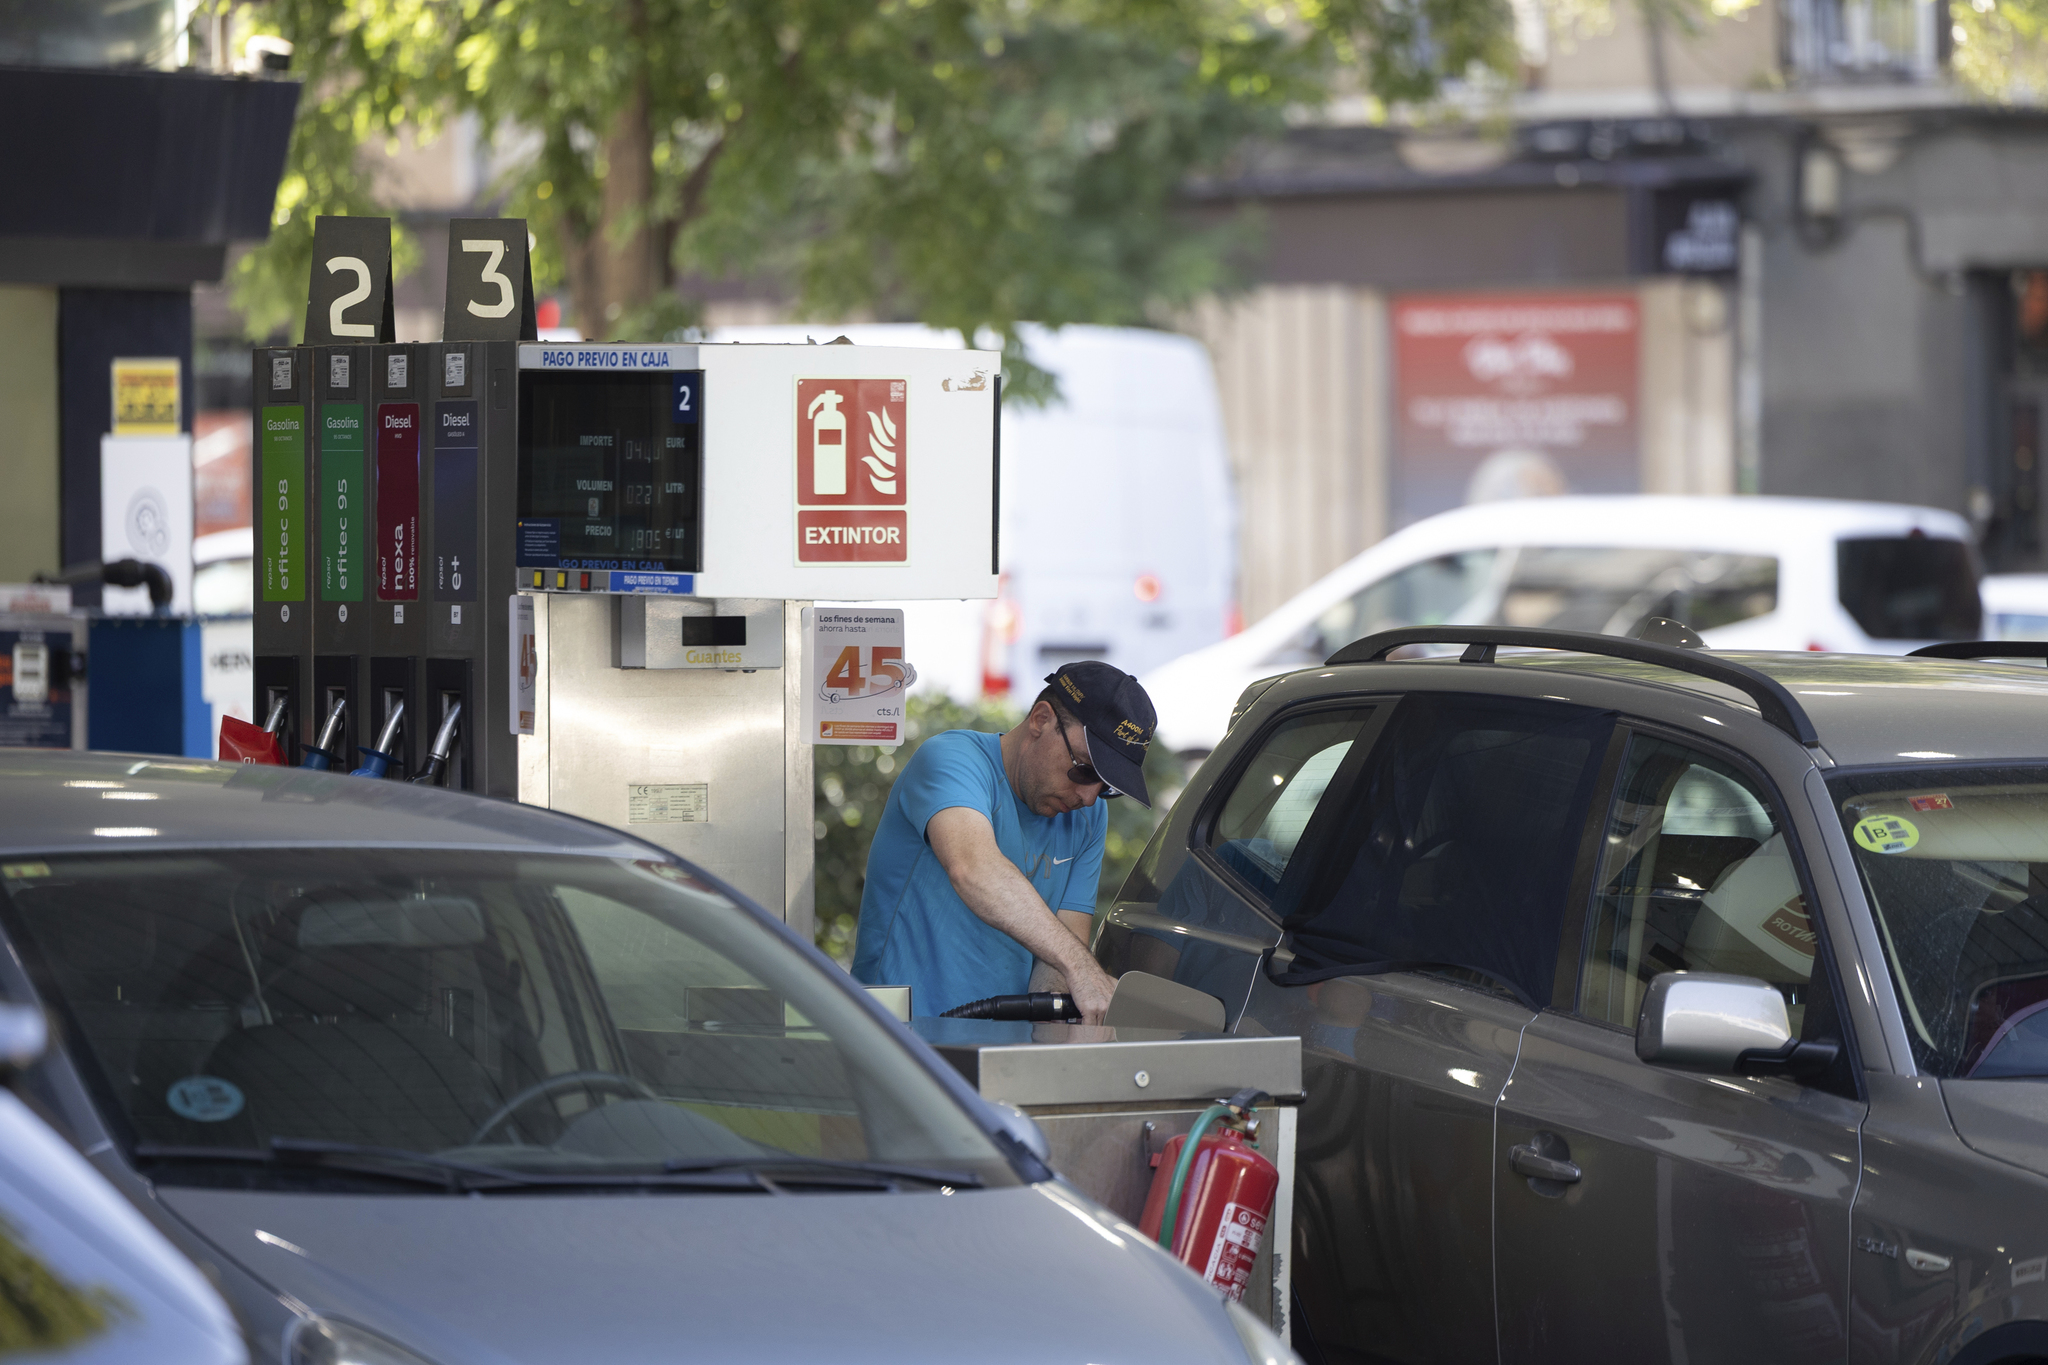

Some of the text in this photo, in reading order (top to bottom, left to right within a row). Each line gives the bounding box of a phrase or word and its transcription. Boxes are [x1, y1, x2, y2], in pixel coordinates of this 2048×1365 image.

[461, 239, 516, 319] 3
[325, 256, 375, 338] 2
[542, 351, 670, 368] PAGO PREVIO EN CAJA
[678, 385, 691, 412] 2
[267, 419, 299, 431] Gasolina
[326, 417, 359, 429] Gasolina
[385, 414, 412, 429] Diesel
[443, 413, 470, 427] Diesel
[580, 435, 613, 447] IMPORTE
[577, 480, 613, 491] VOLUMEN
[665, 482, 685, 493] LITR
[278, 479, 289, 590] efitec 98
[337, 479, 348, 590] efitec 95
[585, 525, 612, 536] PRECIO
[805, 527, 900, 544] EXTINTOR
[394, 523, 404, 590] nexa
[581, 559, 619, 570] PREVIO
[622, 560, 636, 570] EN
[638, 561, 665, 571] CAJA
[451, 556, 461, 590] e+
[819, 615, 895, 624] Los fines de semana
[819, 624, 866, 633] ahorra hasta
[686, 650, 742, 664] Guantes
[826, 646, 905, 699] 45
[1121, 719, 1144, 735] A400M
[1872, 828, 1888, 839] B
